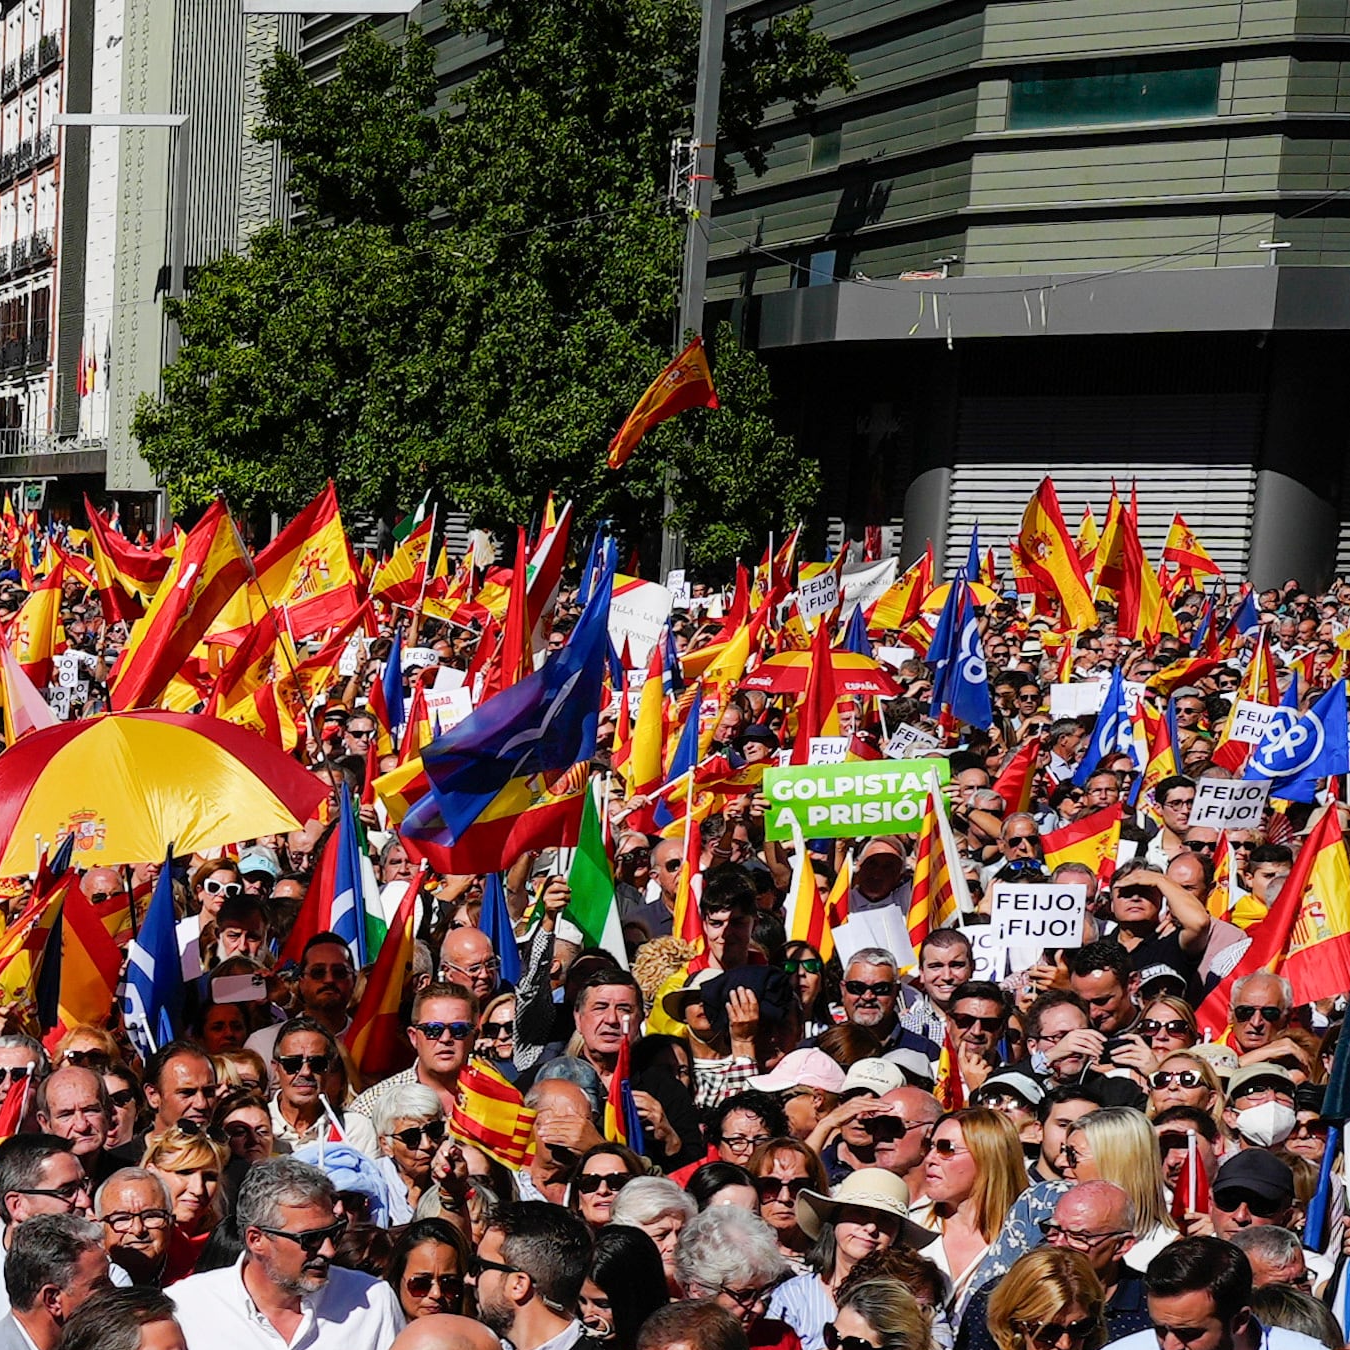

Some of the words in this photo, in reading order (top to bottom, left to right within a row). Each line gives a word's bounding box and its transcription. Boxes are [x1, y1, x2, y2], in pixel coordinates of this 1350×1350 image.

[805, 588, 837, 612] ¡FIJO!
[844, 680, 880, 692] ESPAÑA
[772, 770, 941, 800] GOLPISTAS
[1199, 786, 1265, 801] FEIJO,
[775, 807, 800, 828] A
[1197, 805, 1258, 821] ¡FIJO!
[996, 893, 1082, 913] FEIJO,
[999, 919, 1077, 939] ¡FIJO!
